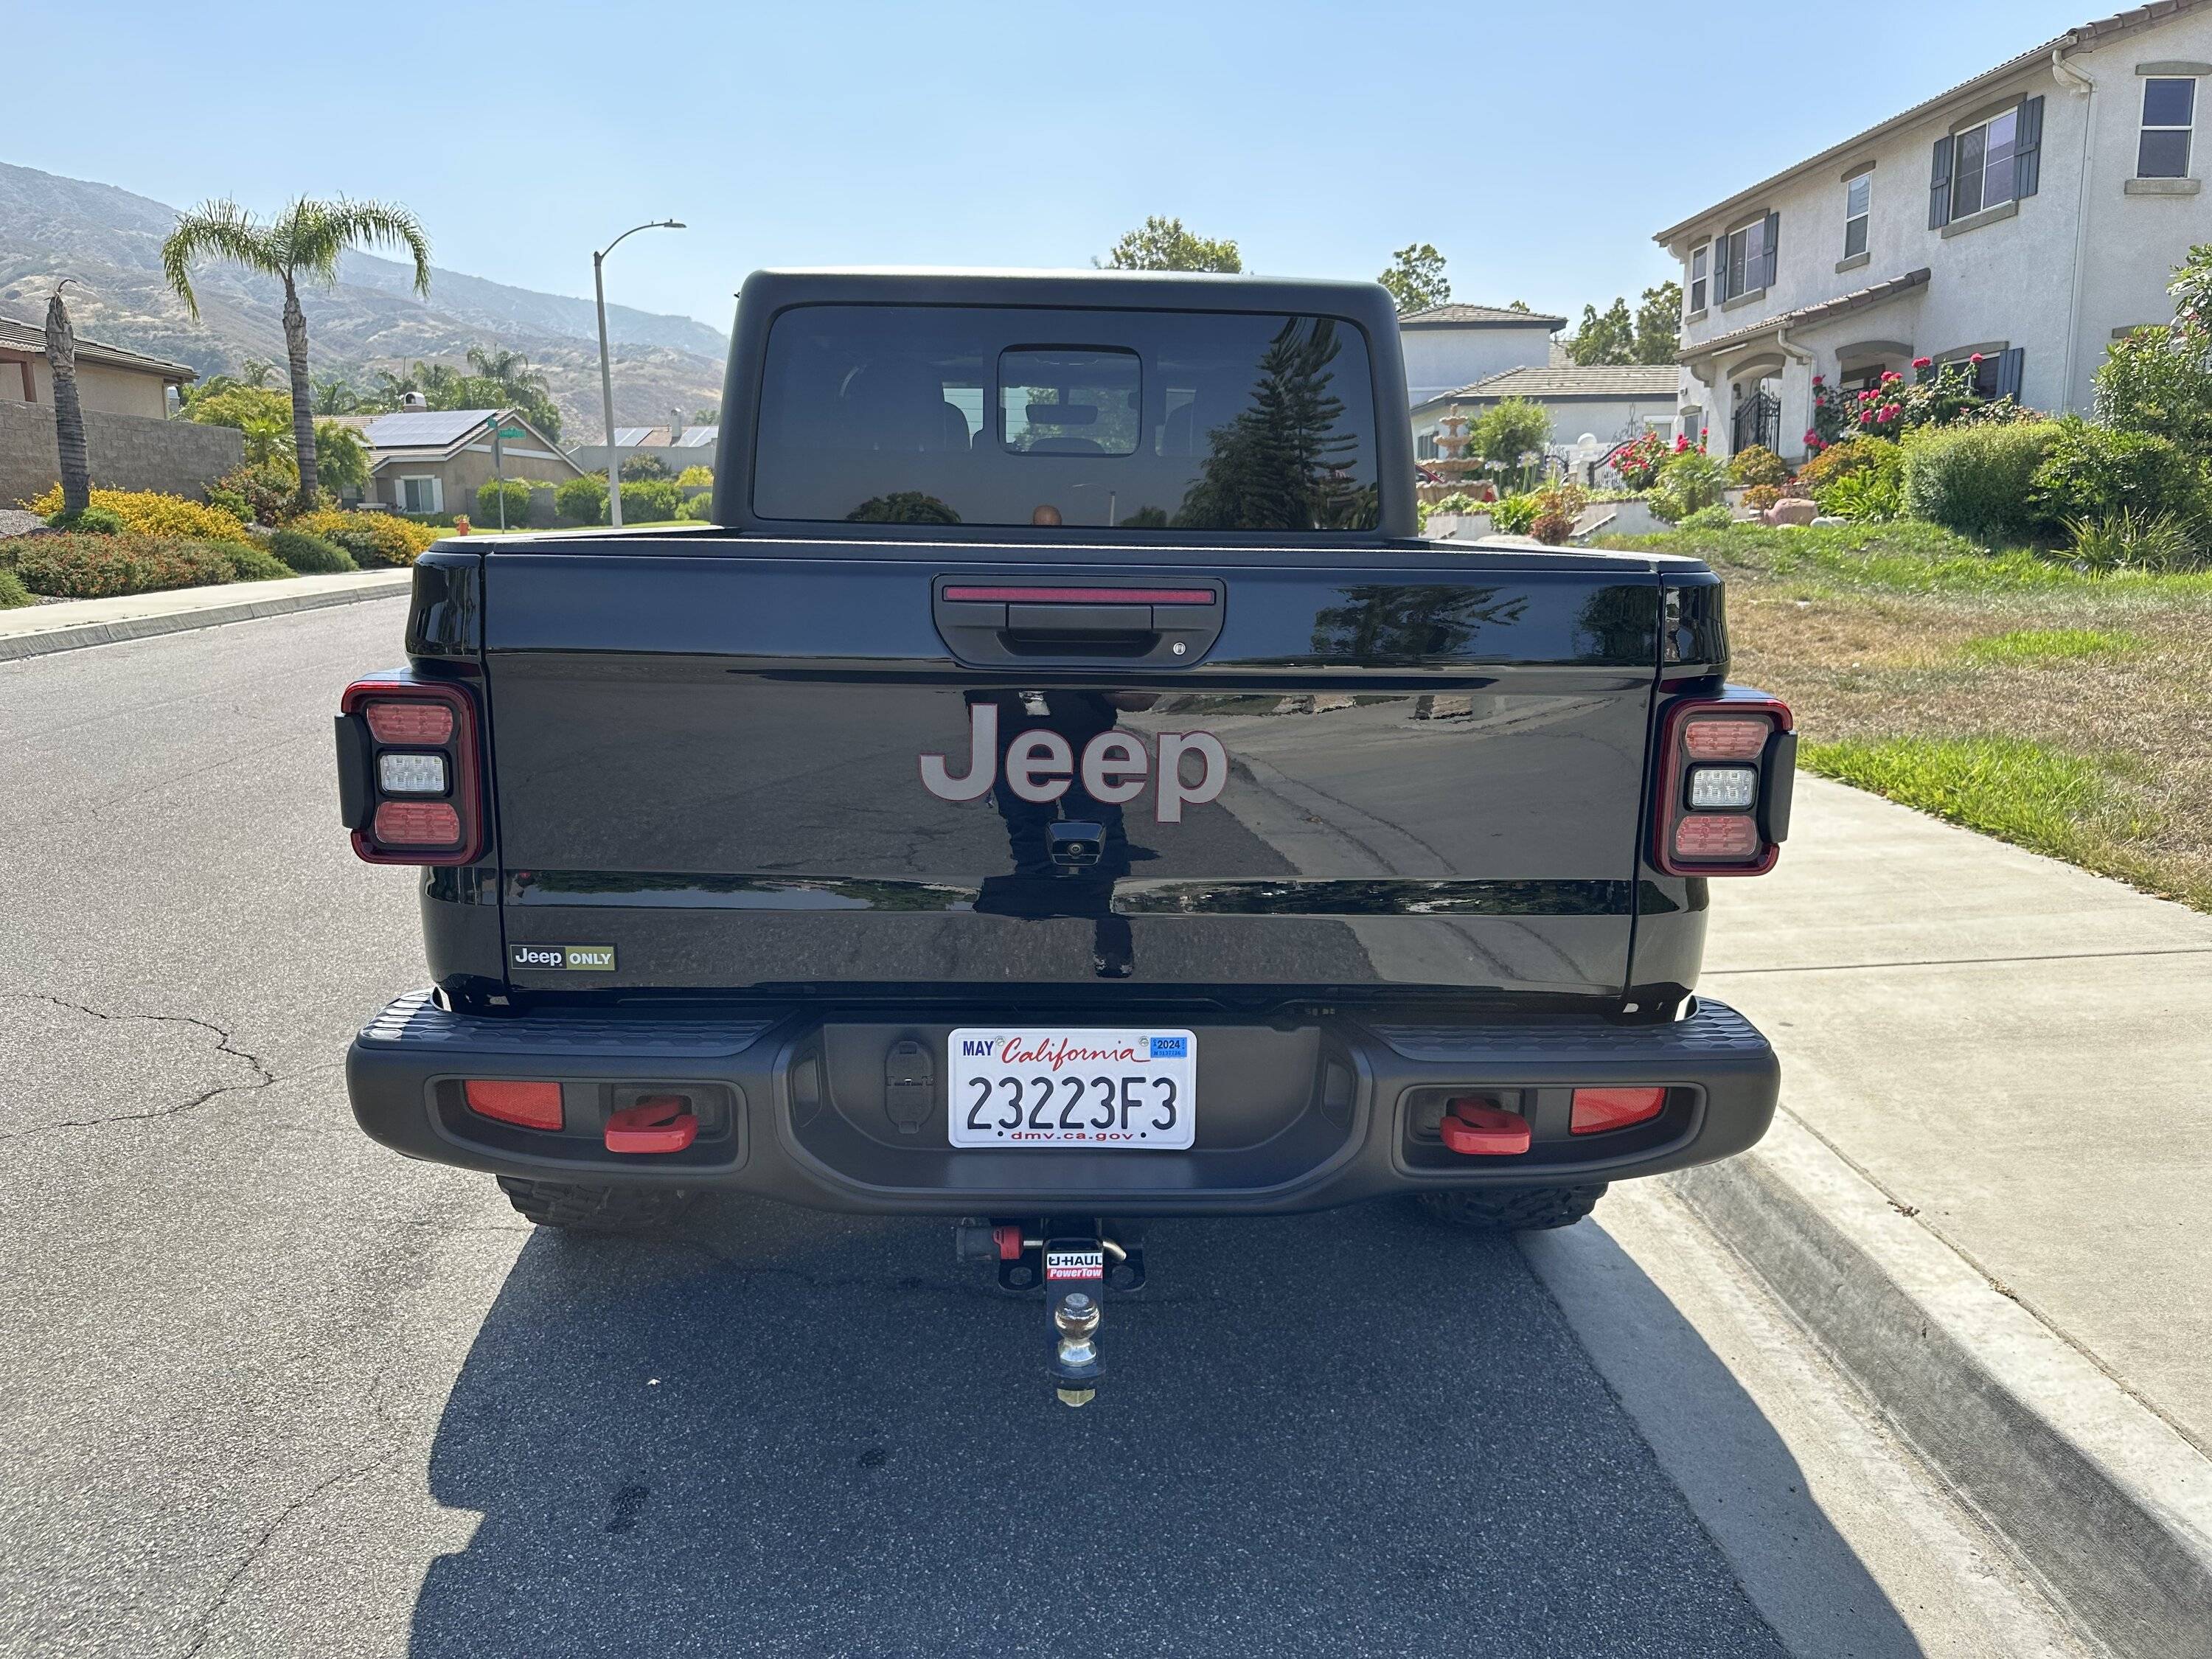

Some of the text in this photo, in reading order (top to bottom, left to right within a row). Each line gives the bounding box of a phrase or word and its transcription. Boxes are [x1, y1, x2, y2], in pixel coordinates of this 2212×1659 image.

[919, 703, 1228, 824] Jeep
[515, 947, 612, 967] Jeep ONLY
[962, 1040, 994, 1056] MAY
[1157, 1040, 1180, 1049] 2024
[1001, 1037, 1150, 1071] California
[967, 1076, 1178, 1130] 23223F3
[1011, 1131, 1134, 1141] dmv.ca.gov
[1048, 1255, 1102, 1266] U-HAUL
[1049, 1268, 1102, 1278] PowerTow
